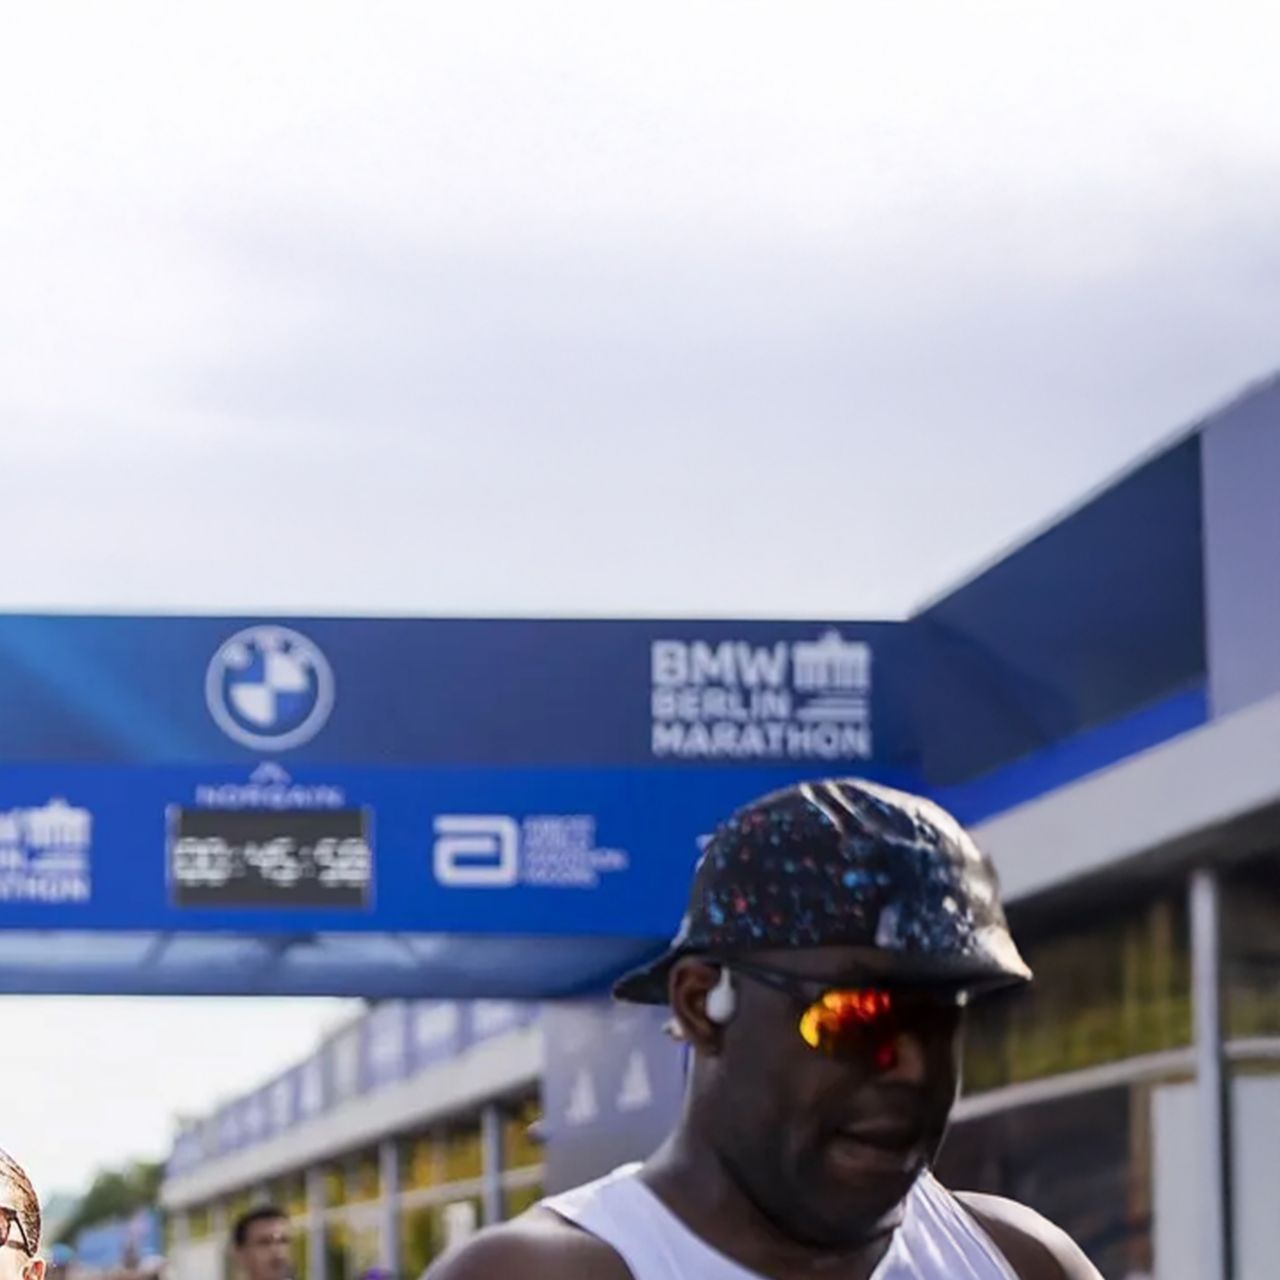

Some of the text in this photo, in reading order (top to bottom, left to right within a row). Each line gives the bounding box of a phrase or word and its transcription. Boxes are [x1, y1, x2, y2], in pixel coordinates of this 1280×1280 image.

[651, 640, 788, 687] BMW
[651, 687, 792, 722] BERLIN
[651, 720, 871, 758] MARATHON
